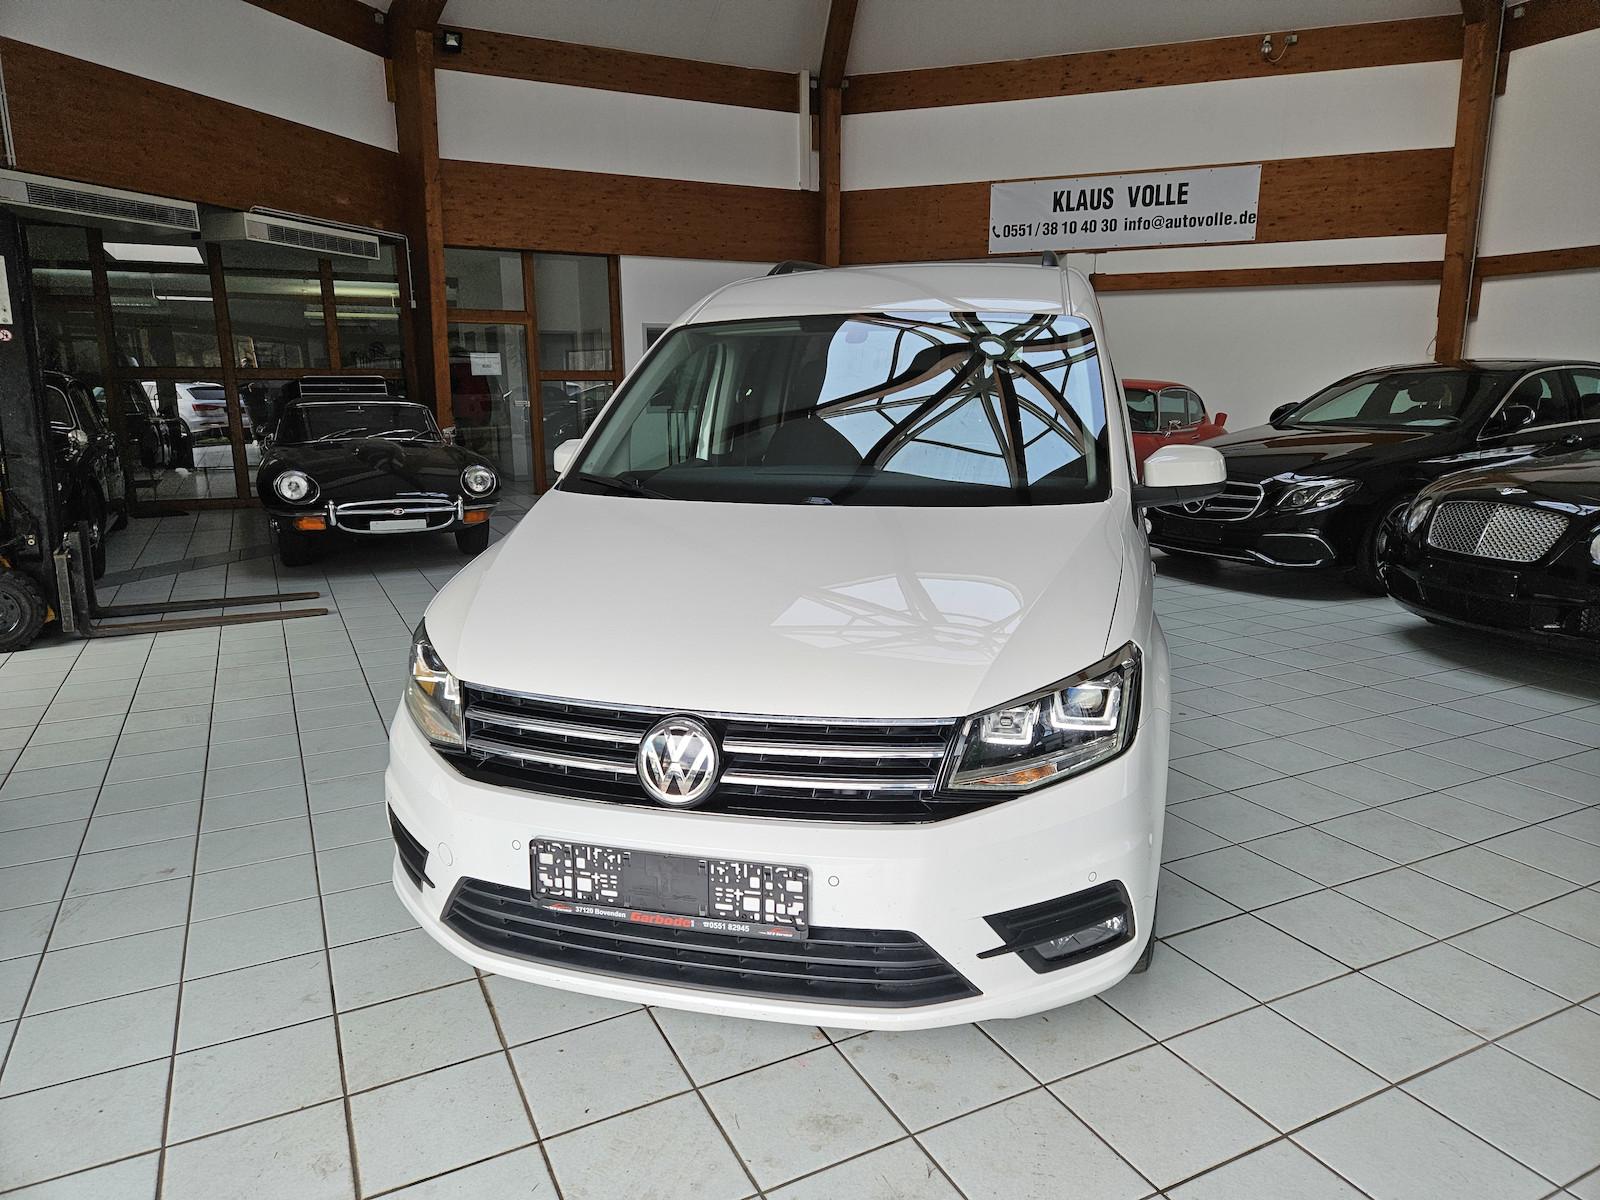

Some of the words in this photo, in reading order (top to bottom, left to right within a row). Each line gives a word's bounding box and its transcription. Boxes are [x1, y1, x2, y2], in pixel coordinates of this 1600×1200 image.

[1052, 187, 1114, 212] KLAUS
[1127, 182, 1190, 208] VOLLE
[1062, 221, 1077, 235] 10
[1080, 219, 1097, 233] 40
[1101, 218, 1117, 232] 30
[1123, 210, 1256, 232] info@autovolle.de
[575, 906, 594, 914] 37120
[594, 909, 626, 918] Bovenden
[727, 923, 750, 932] 82945
